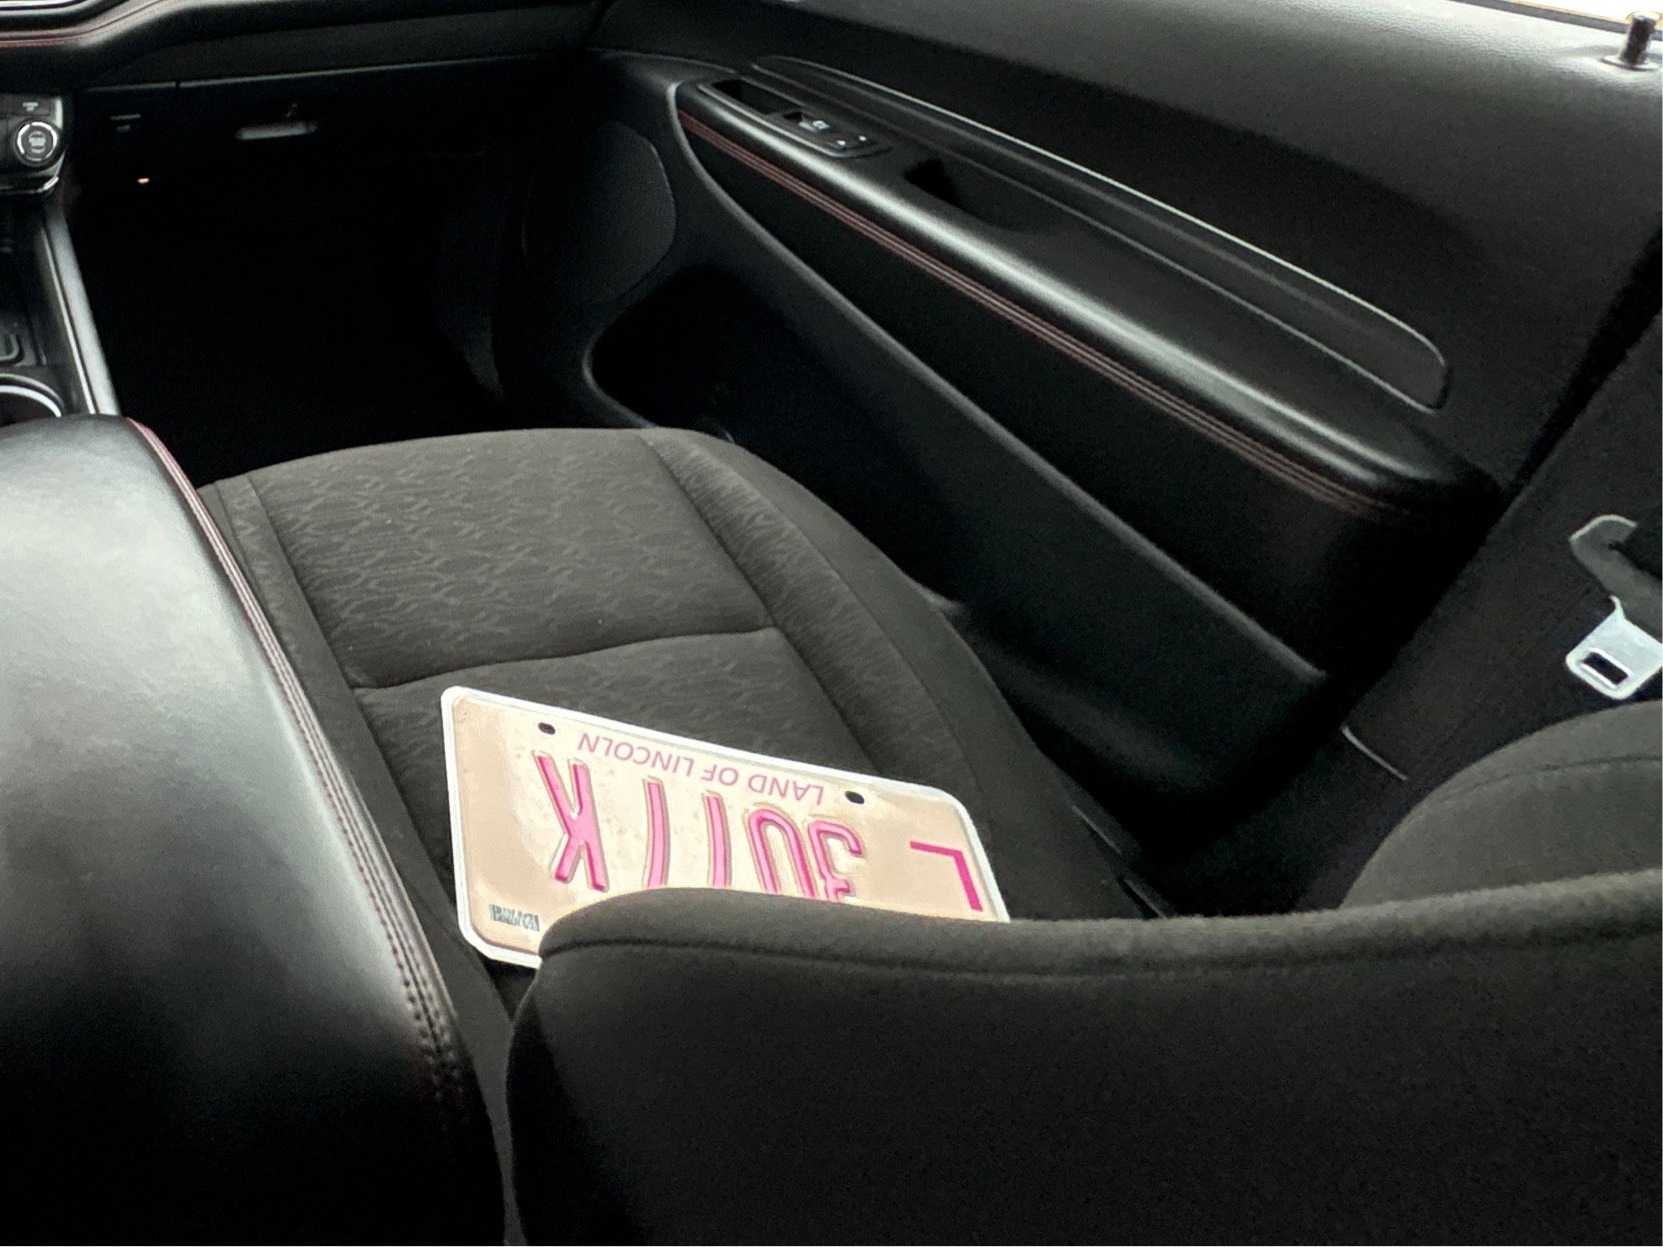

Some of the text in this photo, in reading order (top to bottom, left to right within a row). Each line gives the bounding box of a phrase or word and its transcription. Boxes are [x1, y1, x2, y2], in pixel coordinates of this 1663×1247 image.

[577, 732, 825, 806] LAND OF LINCOLN
